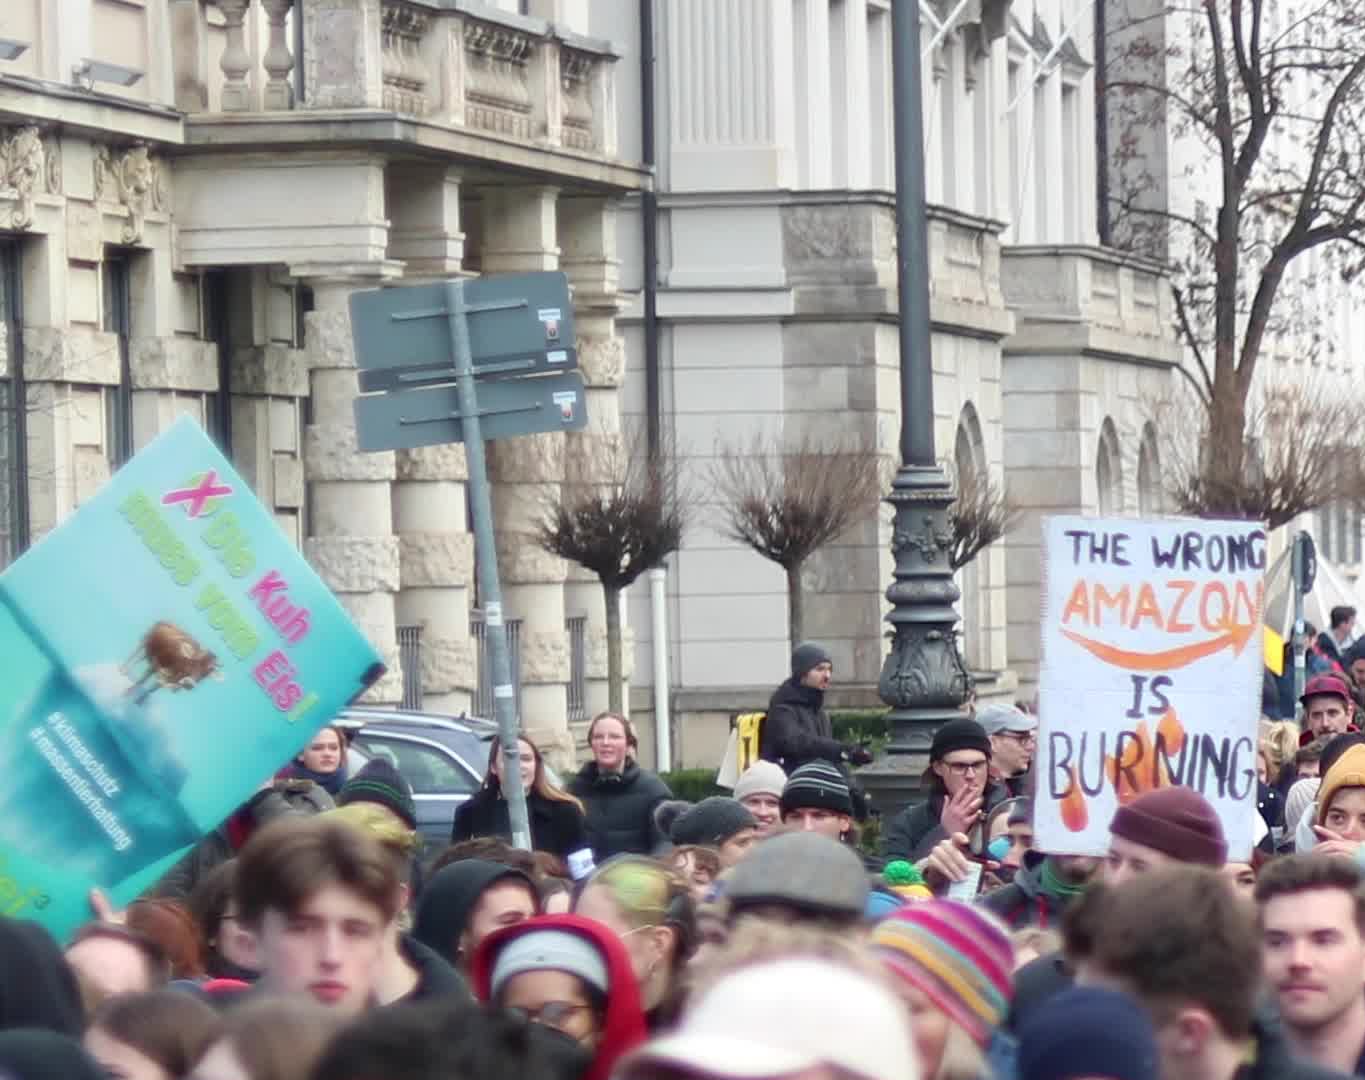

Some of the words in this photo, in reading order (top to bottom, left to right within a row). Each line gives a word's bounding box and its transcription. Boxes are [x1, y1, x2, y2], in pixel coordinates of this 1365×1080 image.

[1064, 530, 1131, 566] THE
[1152, 530, 1265, 573] WRONG
[248, 569, 312, 645] Kuh
[1062, 578, 1264, 633] AMAZON
[1126, 674, 1173, 719] IS
[1049, 729, 1256, 801] BURNING
